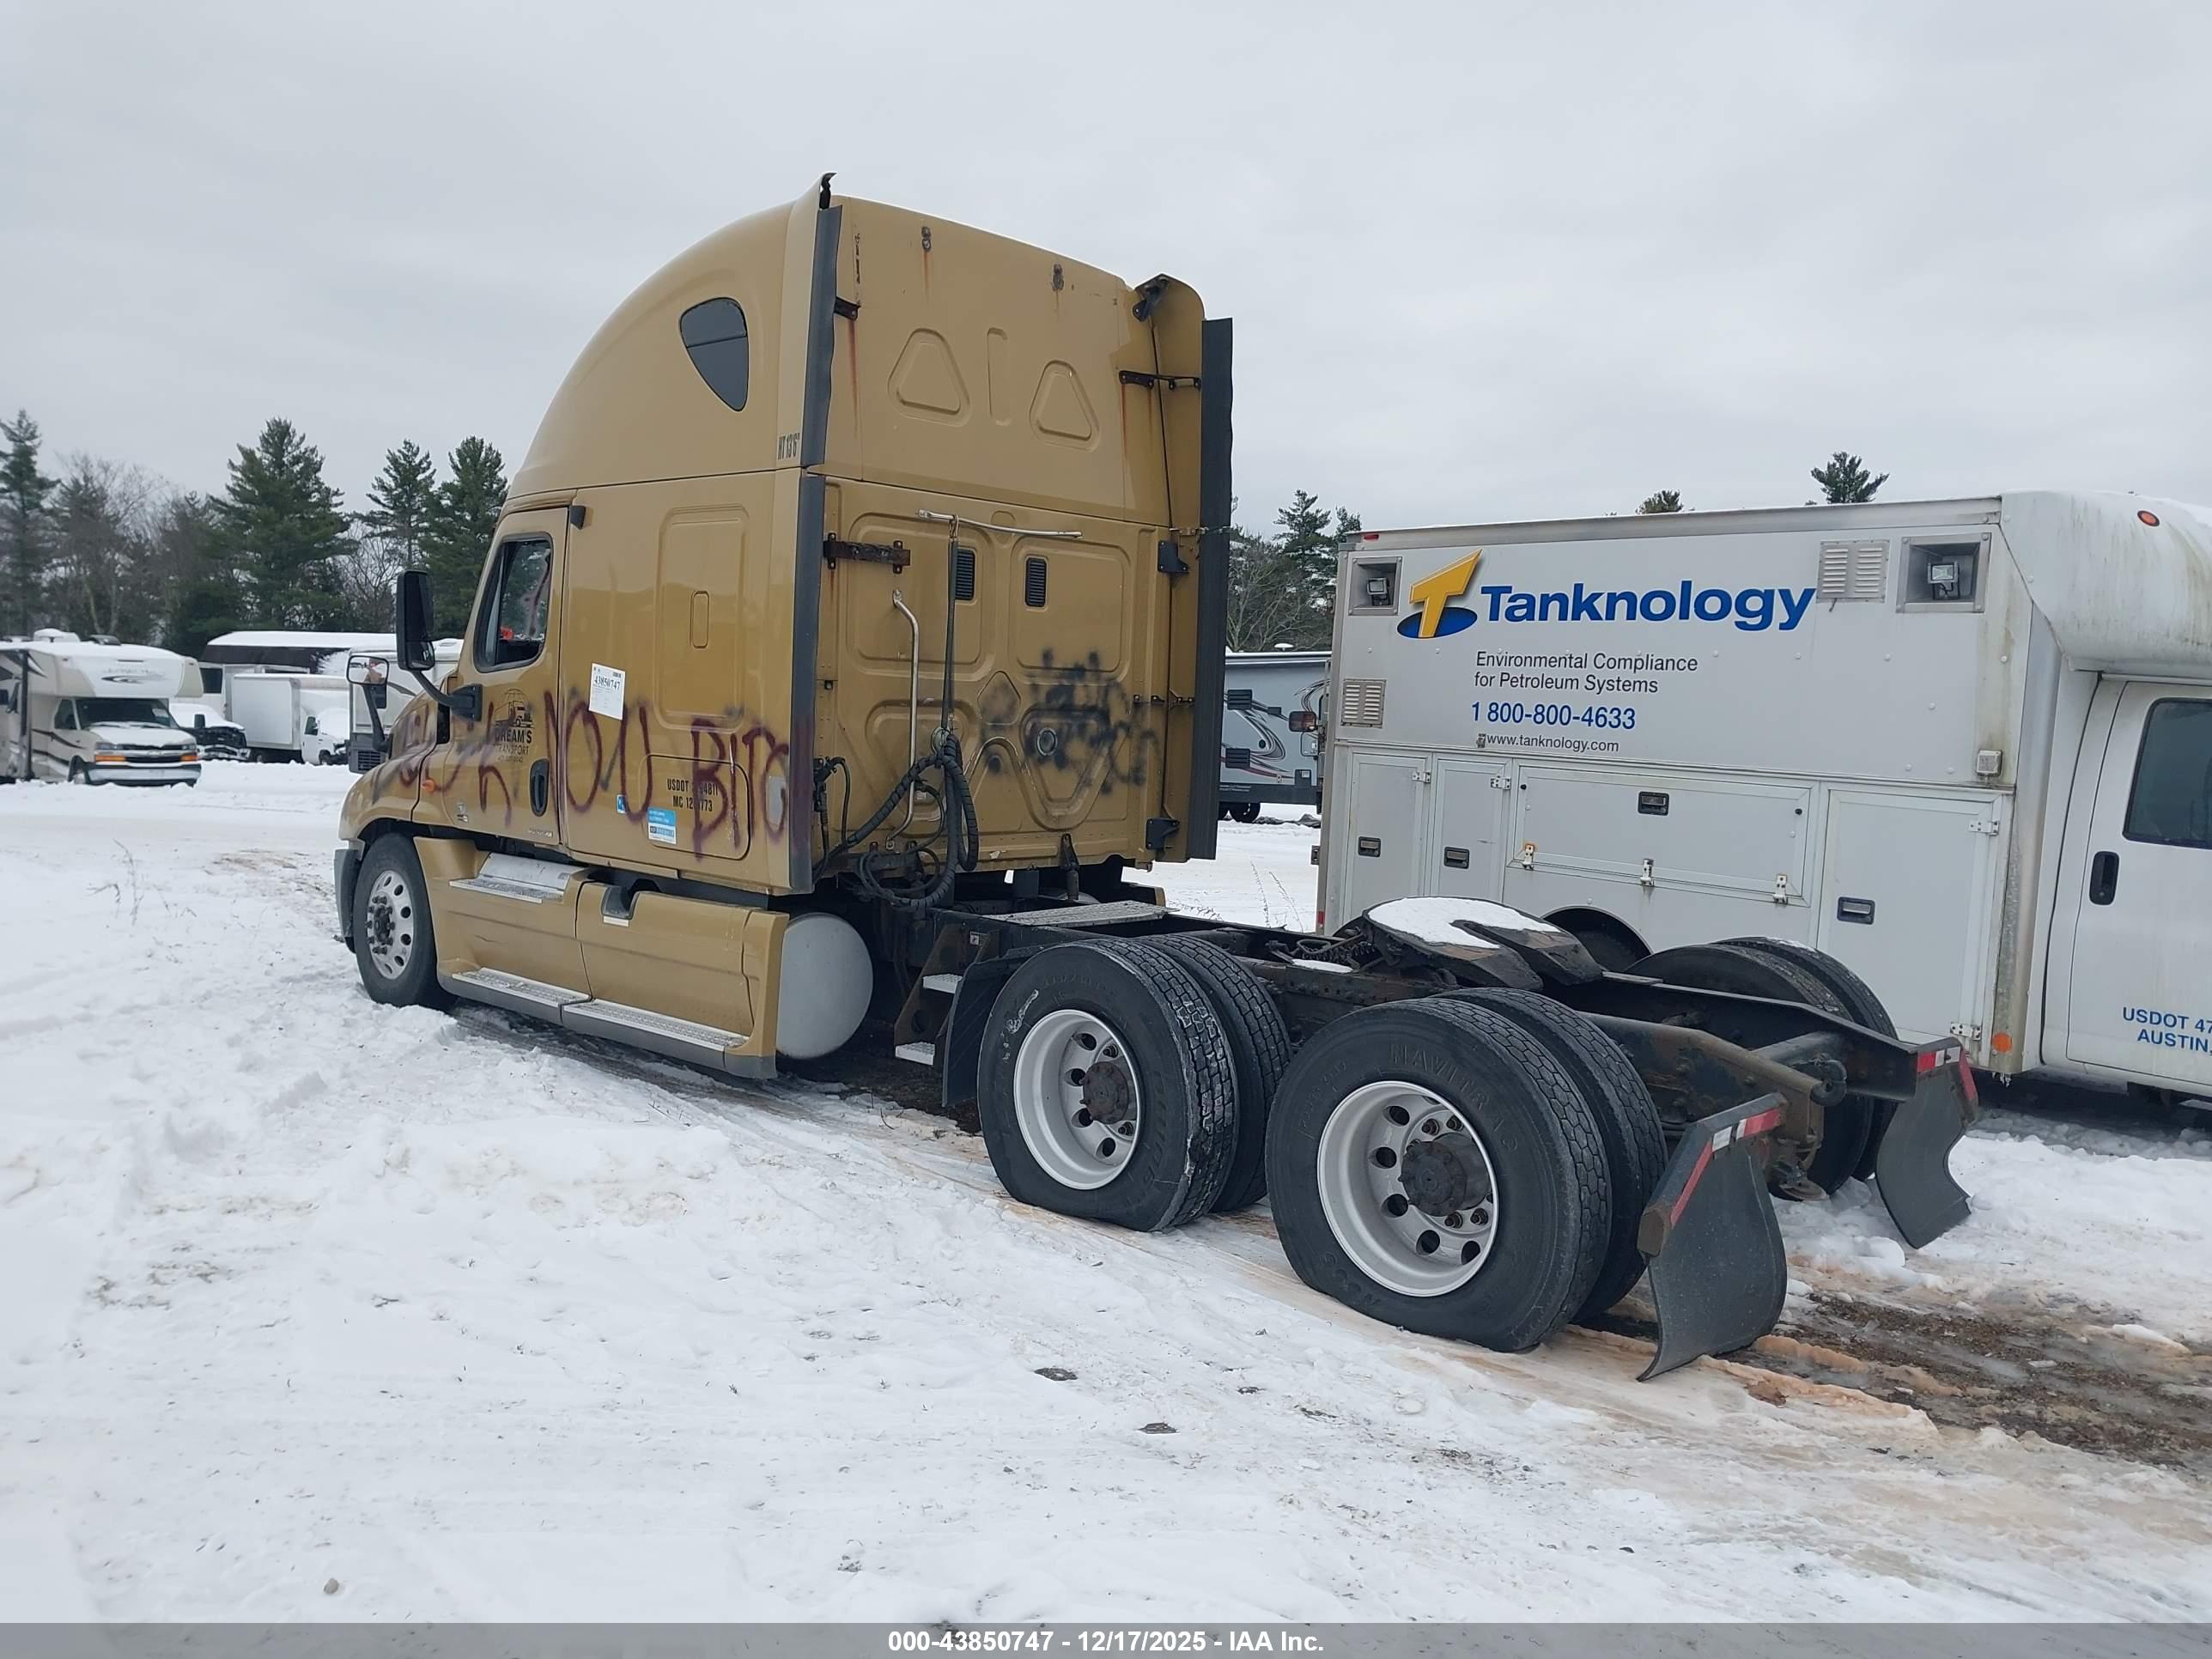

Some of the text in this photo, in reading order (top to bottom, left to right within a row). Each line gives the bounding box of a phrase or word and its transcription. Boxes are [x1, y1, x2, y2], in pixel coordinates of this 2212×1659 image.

[1480, 580, 1815, 632] Tanknology
[1476, 651, 1698, 674] Environmental Compliance
[1474, 672, 1659, 695] for Petroleum Systems
[1472, 701, 1636, 730] 1 800-800-4633
[1486, 733, 1620, 753] www.tanknology.com
[666, 778, 690, 793] USDOT
[672, 795, 684, 808] MC
[2123, 1006, 2190, 1030] USDOT
